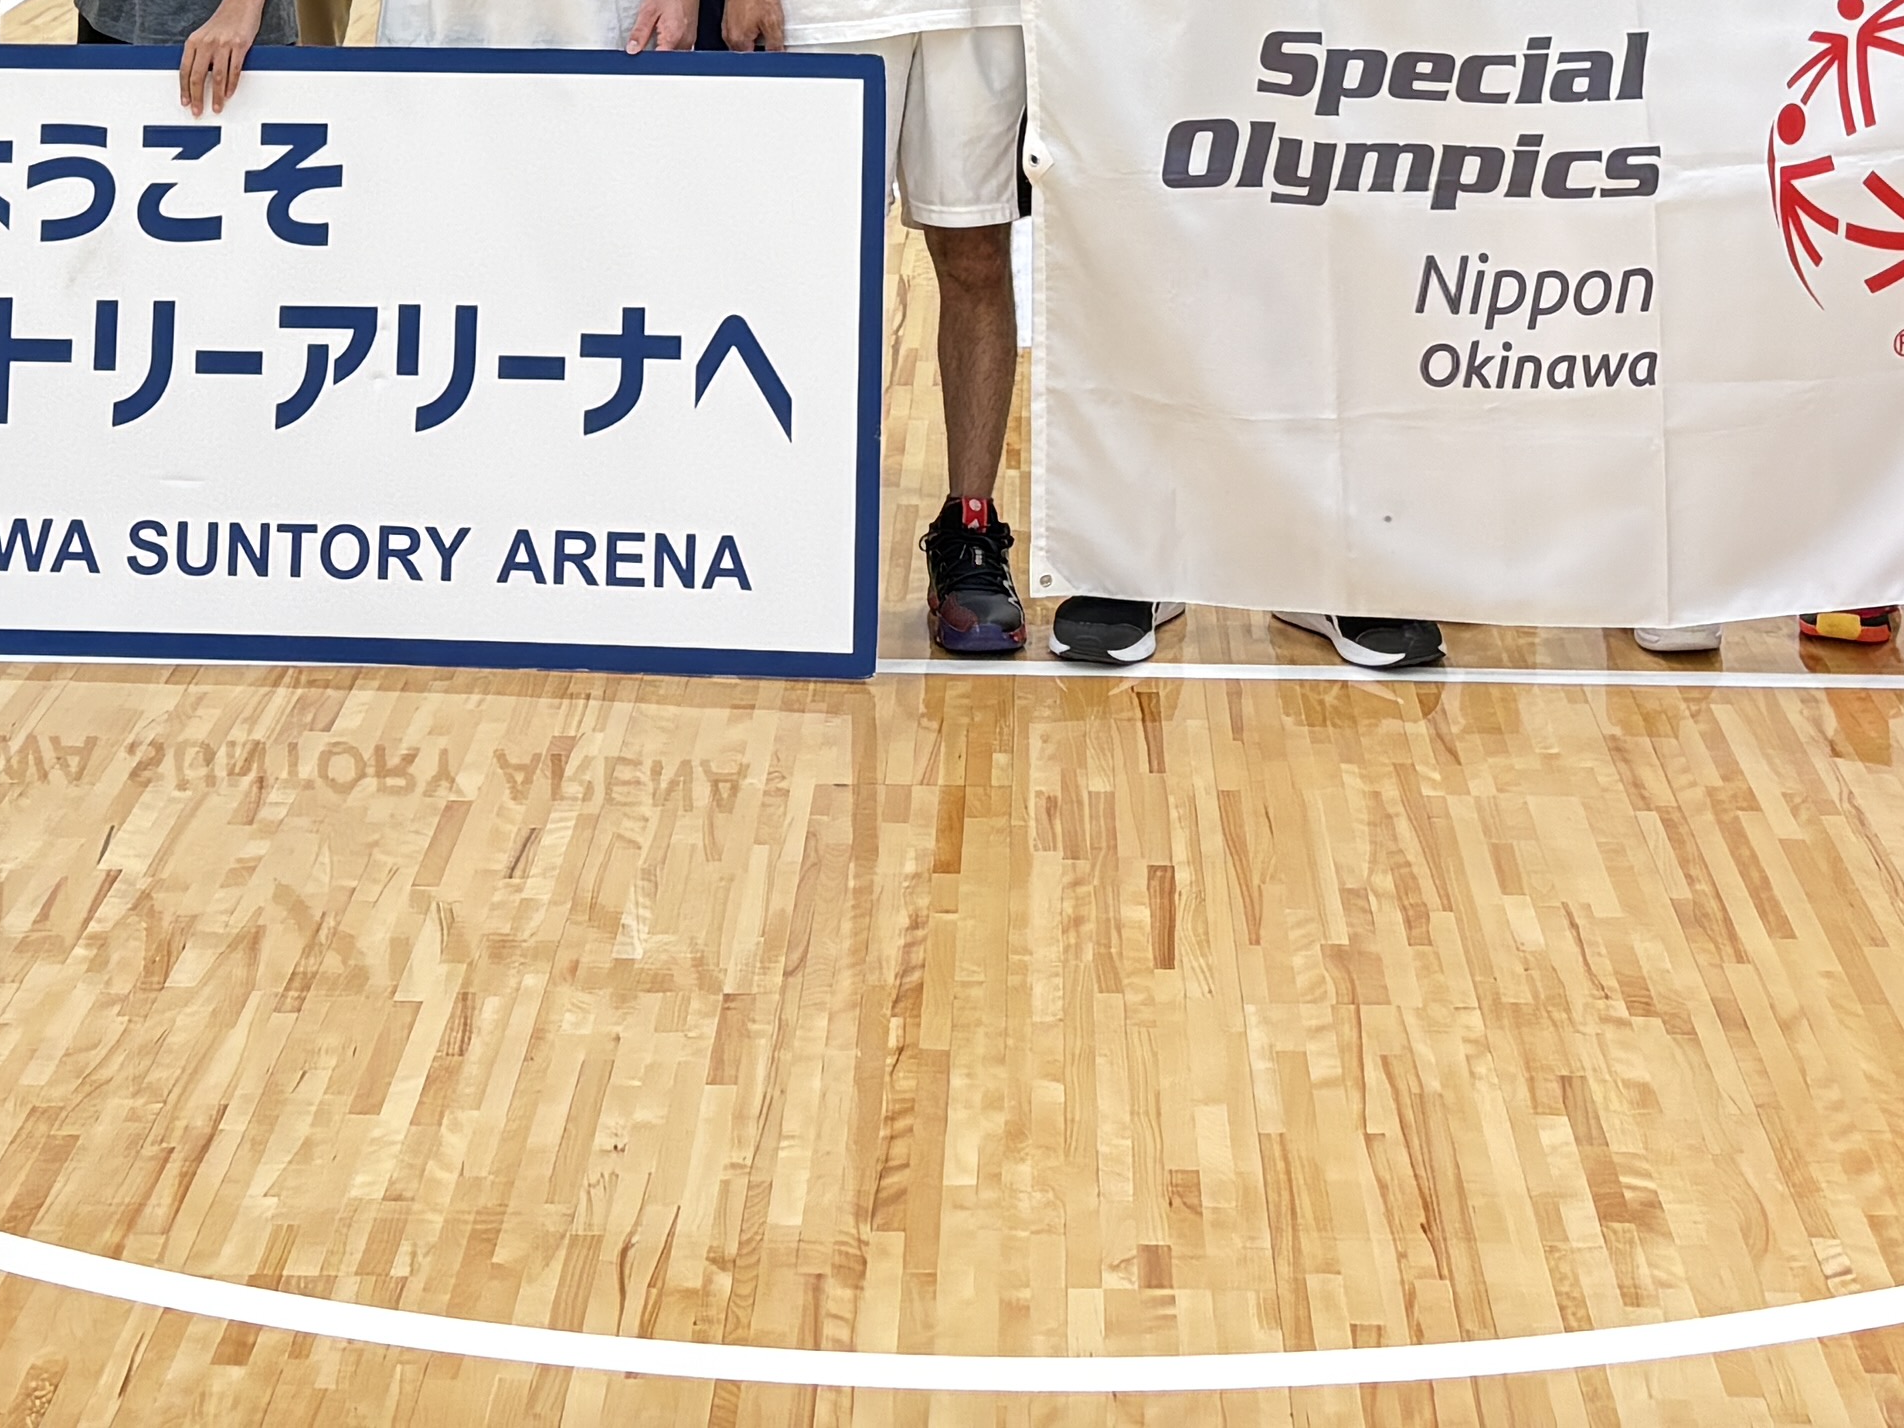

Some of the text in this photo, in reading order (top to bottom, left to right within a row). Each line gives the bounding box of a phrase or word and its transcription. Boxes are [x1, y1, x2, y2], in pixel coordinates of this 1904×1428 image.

[1256, 30, 1650, 117] Special
[1161, 116, 1662, 211] Olympics
[1415, 251, 1655, 331] Nippon
[1420, 339, 1659, 391] Okinawa
[125, 518, 473, 583] SUNTORY
[495, 528, 753, 593] ARENA
